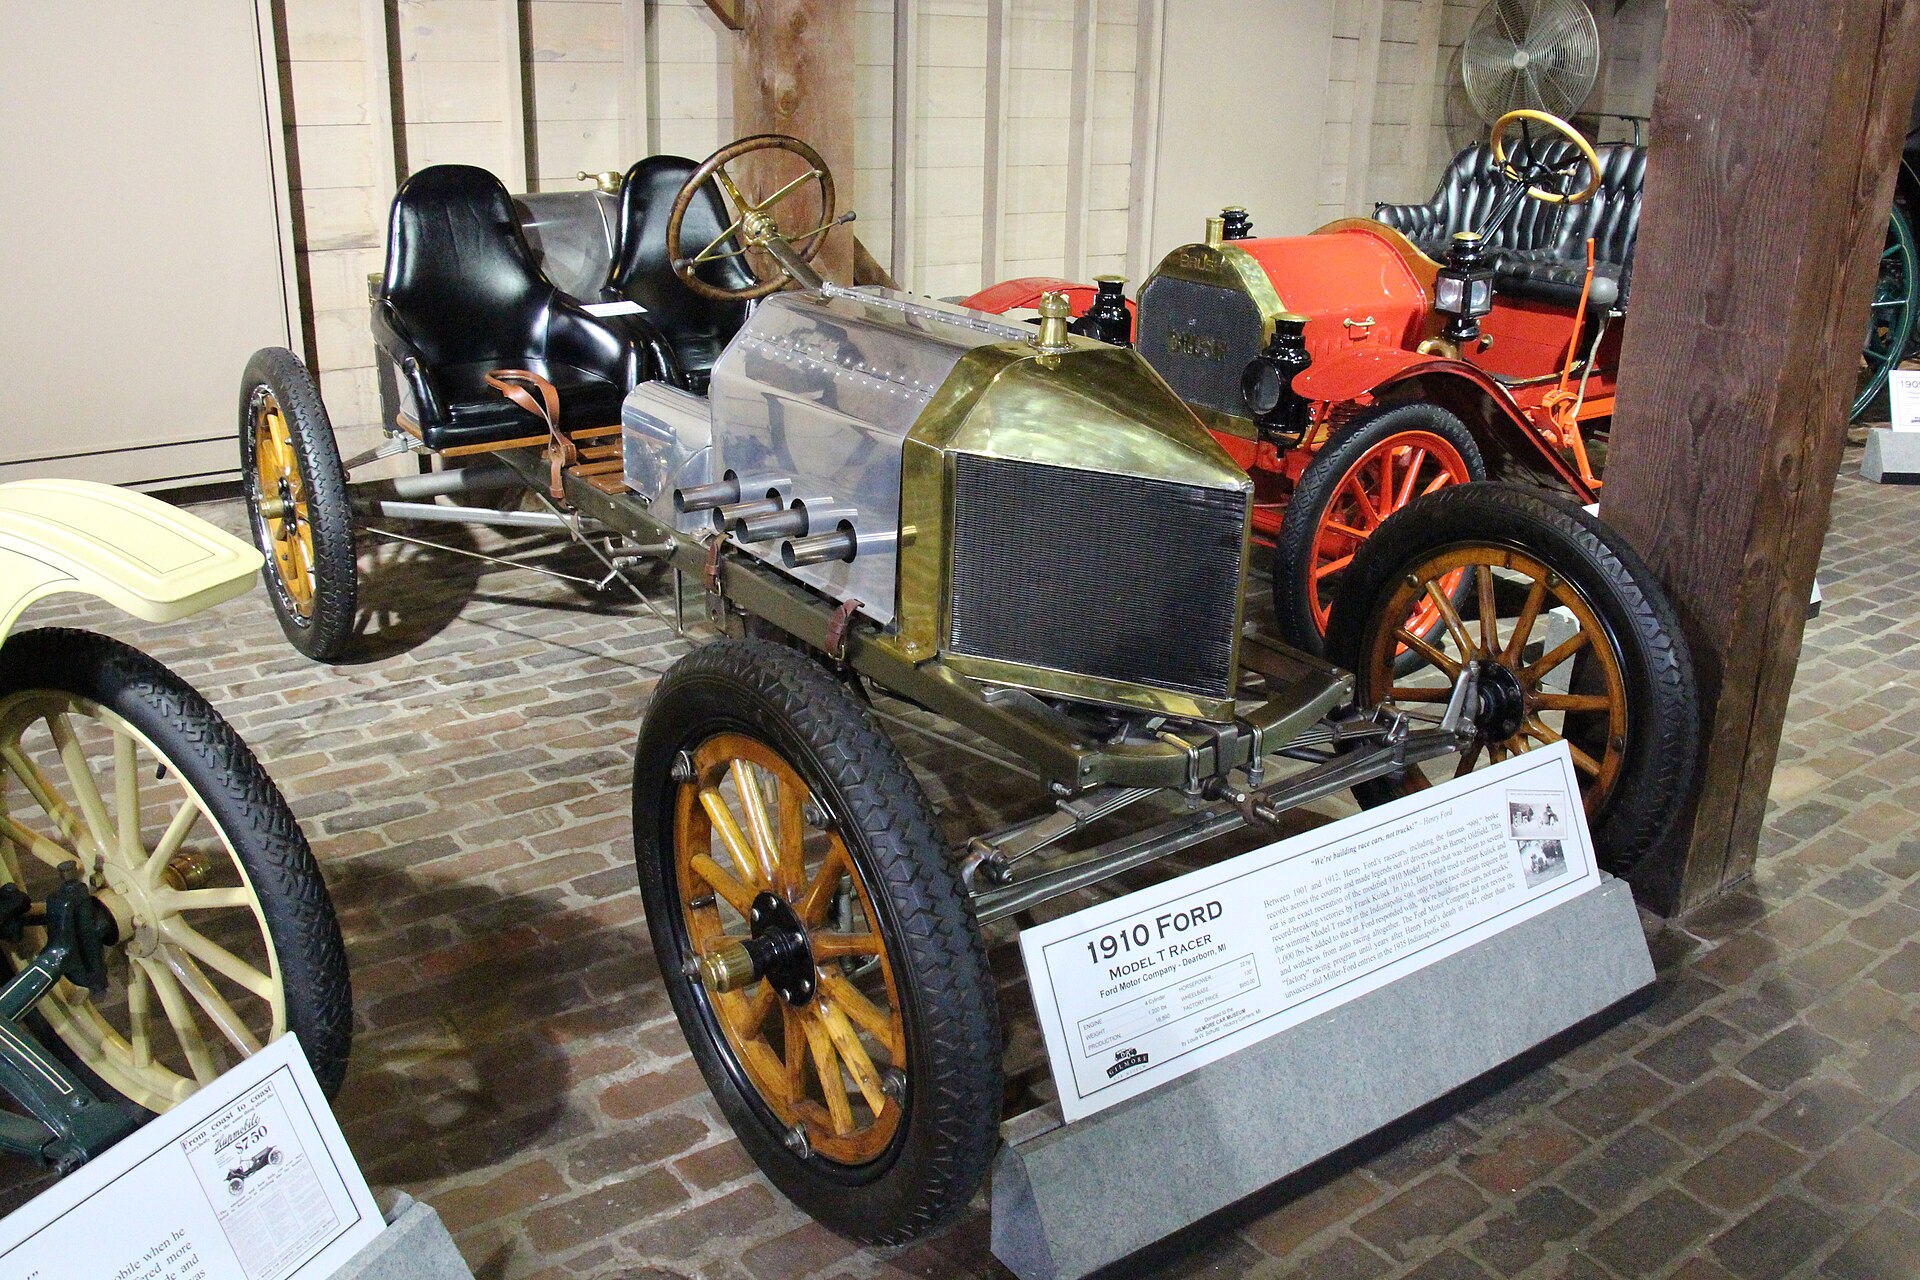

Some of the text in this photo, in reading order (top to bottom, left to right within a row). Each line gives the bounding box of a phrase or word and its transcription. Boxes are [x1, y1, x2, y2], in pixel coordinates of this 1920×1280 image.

[1333, 846, 1357, 859] building
[1358, 841, 1370, 850] race
[1371, 837, 1384, 845] cars,
[1386, 831, 1395, 839] not
[1424, 816, 1439, 825] Henry
[1440, 808, 1453, 819] Ford
[1264, 894, 1290, 908] Between
[1293, 885, 1307, 897] 1901
[1311, 880, 1322, 890] and
[1343, 867, 1360, 877] Henry
[1410, 838, 1434, 852] including
[1446, 826, 1465, 837] famous
[1485, 812, 1499, 822] broke
[1267, 823, 1501, 919] records across the country and made legends out of drivers such This
[1269, 923, 1278, 931] car
[1288, 916, 1296, 924] an
[1297, 909, 1313, 920] exact
[1314, 898, 1343, 913] recreation
[1344, 891, 1351, 901] of
[1352, 890, 1361, 898] the
[1363, 878, 1387, 894] modified
[1389, 872, 1402, 883] 1910
[1403, 865, 1420, 877] Model
[1427, 857, 1440, 867] Ford
[1441, 853, 1451, 862] that
[1463, 843, 1479, 853] driven
[1487, 831, 1504, 843] several
[1272, 919, 1319, 942] record-breaking
[1320, 909, 1344, 922] victories
[1345, 905, 1353, 913] by
[1354, 897, 1371, 909] Frank
[1416, 873, 1432, 883] Henry
[1433, 866, 1446, 876] Ford
[1447, 860, 1459, 871] tried
[1466, 854, 1478, 863] enter
[1497, 841, 1506, 850] and
[1274, 945, 1284, 954] the
[1286, 935, 1310, 948] winning
[1311, 925, 1330, 937] Model
[1330, 922, 1335, 930] T
[1337, 918, 1351, 928] racer
[1369, 897, 1403, 914] Indianapolis
[1417, 885, 1428, 895] only
[1435, 878, 1448, 887] have
[1448, 873, 1459, 881] race
[1461, 864, 1480, 876] officials
[1481, 857, 1498, 868] require
[1499, 852, 1508, 860] that
[1295, 949, 1305, 957] lbs
[1315, 936, 1332, 949] added
[1361, 918, 1375, 930] Ford
[1376, 906, 1403, 923] responded
[1437, 885, 1459, 897] building
[1459, 880, 1470, 888] race
[1483, 870, 1492, 878] not
[1088, 901, 1222, 963] 1910 FORD
[1280, 965, 1291, 976] and
[1293, 956, 1320, 969] withdrew
[1323, 948, 1337, 958] from
[1339, 942, 1351, 951] auto
[1353, 934, 1371, 945] racing
[1401, 916, 1412, 924] The
[1413, 907, 1427, 919] Ford
[1428, 902, 1444, 913] Motor
[1445, 892, 1469, 905] Company
[1471, 885, 1480, 894] did
[1480, 882, 1489, 890] not
[1490, 876, 1505, 886] revive
[1312, 963, 1331, 974] racing
[1333, 952, 1357, 967] program
[1359, 943, 1372, 954] until
[1374, 938, 1389, 950] years
[1391, 931, 1403, 941] after
[1405, 924, 1421, 934] Henry
[1442, 907, 1456, 918] death
[1481, 892, 1493, 901] other
[1495, 887, 1506, 895] than
[1100, 944, 1226, 998] Ford Motor Company Dearborn, MI
[1109, 934, 1211, 980] MODEL T RACER
[1285, 976, 1322, 998] unsuccessful
[1323, 962, 1357, 980] Miller-Ford
[1358, 955, 1376, 967] entries
[1407, 927, 1439, 945] Indianapolis
[1179, 975, 1211, 991] HORSEPOWER
[1181, 987, 1208, 1001] WHEELBASE
[1183, 999, 1204, 1011] FACTORY
[1083, 1019, 1102, 1030] ENGINE
[1086, 1028, 1105, 1040] WEIGHT
[1088, 1034, 1121, 1050] PRODUCTION
[1195, 1022, 1215, 1033] GILMORE
[1226, 1009, 1245, 1020] MUSEUM
[1109, 1056, 1148, 1076] GILMORE
[182, 1086, 271, 1150] From coast to coast
[235, 1126, 267, 1154] $750
[143, 1240, 170, 1261] when
[171, 1228, 185, 1241] he
[166, 1242, 192, 1265] more
[180, 1253, 199, 1273] and
